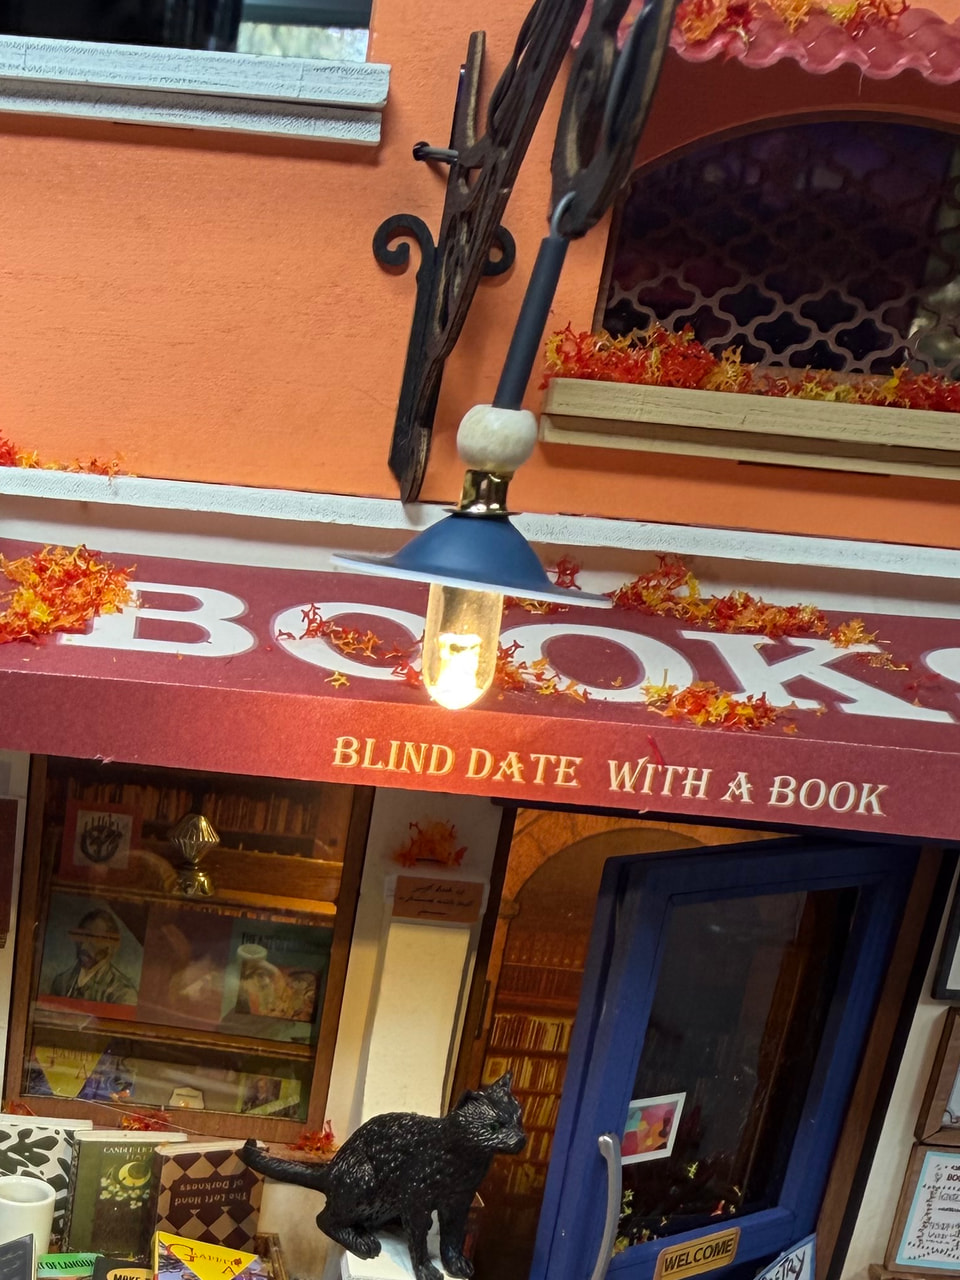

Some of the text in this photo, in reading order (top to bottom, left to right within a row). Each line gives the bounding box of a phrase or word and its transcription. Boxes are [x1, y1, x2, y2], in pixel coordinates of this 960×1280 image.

[332, 735, 890, 817] BLIND DATE WITH A BOOK
[180, 1180, 230, 1192] Darkness
[175, 1195, 202, 1206] Hand
[663, 1238, 735, 1273] WELCOME
[47, 1261, 58, 1270] OF
